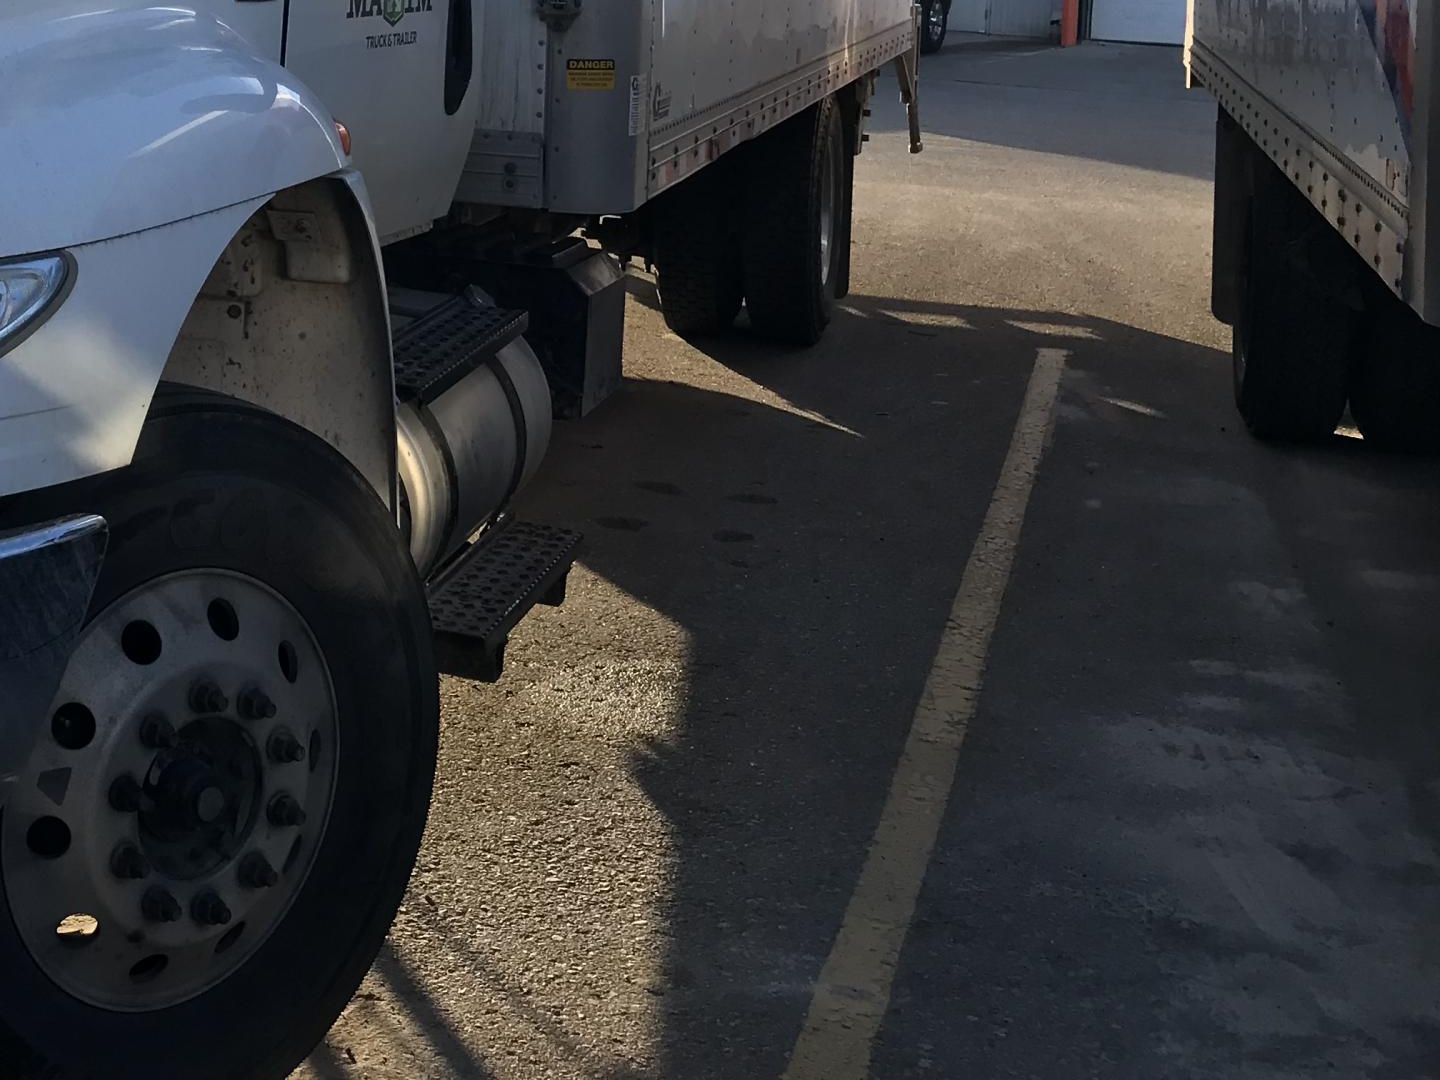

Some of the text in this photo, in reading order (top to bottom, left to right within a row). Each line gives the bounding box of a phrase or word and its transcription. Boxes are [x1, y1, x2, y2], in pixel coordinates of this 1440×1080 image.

[365, 34, 387, 49] TRUCK
[393, 31, 417, 47] TRAILER
[569, 61, 614, 69] DANGER
